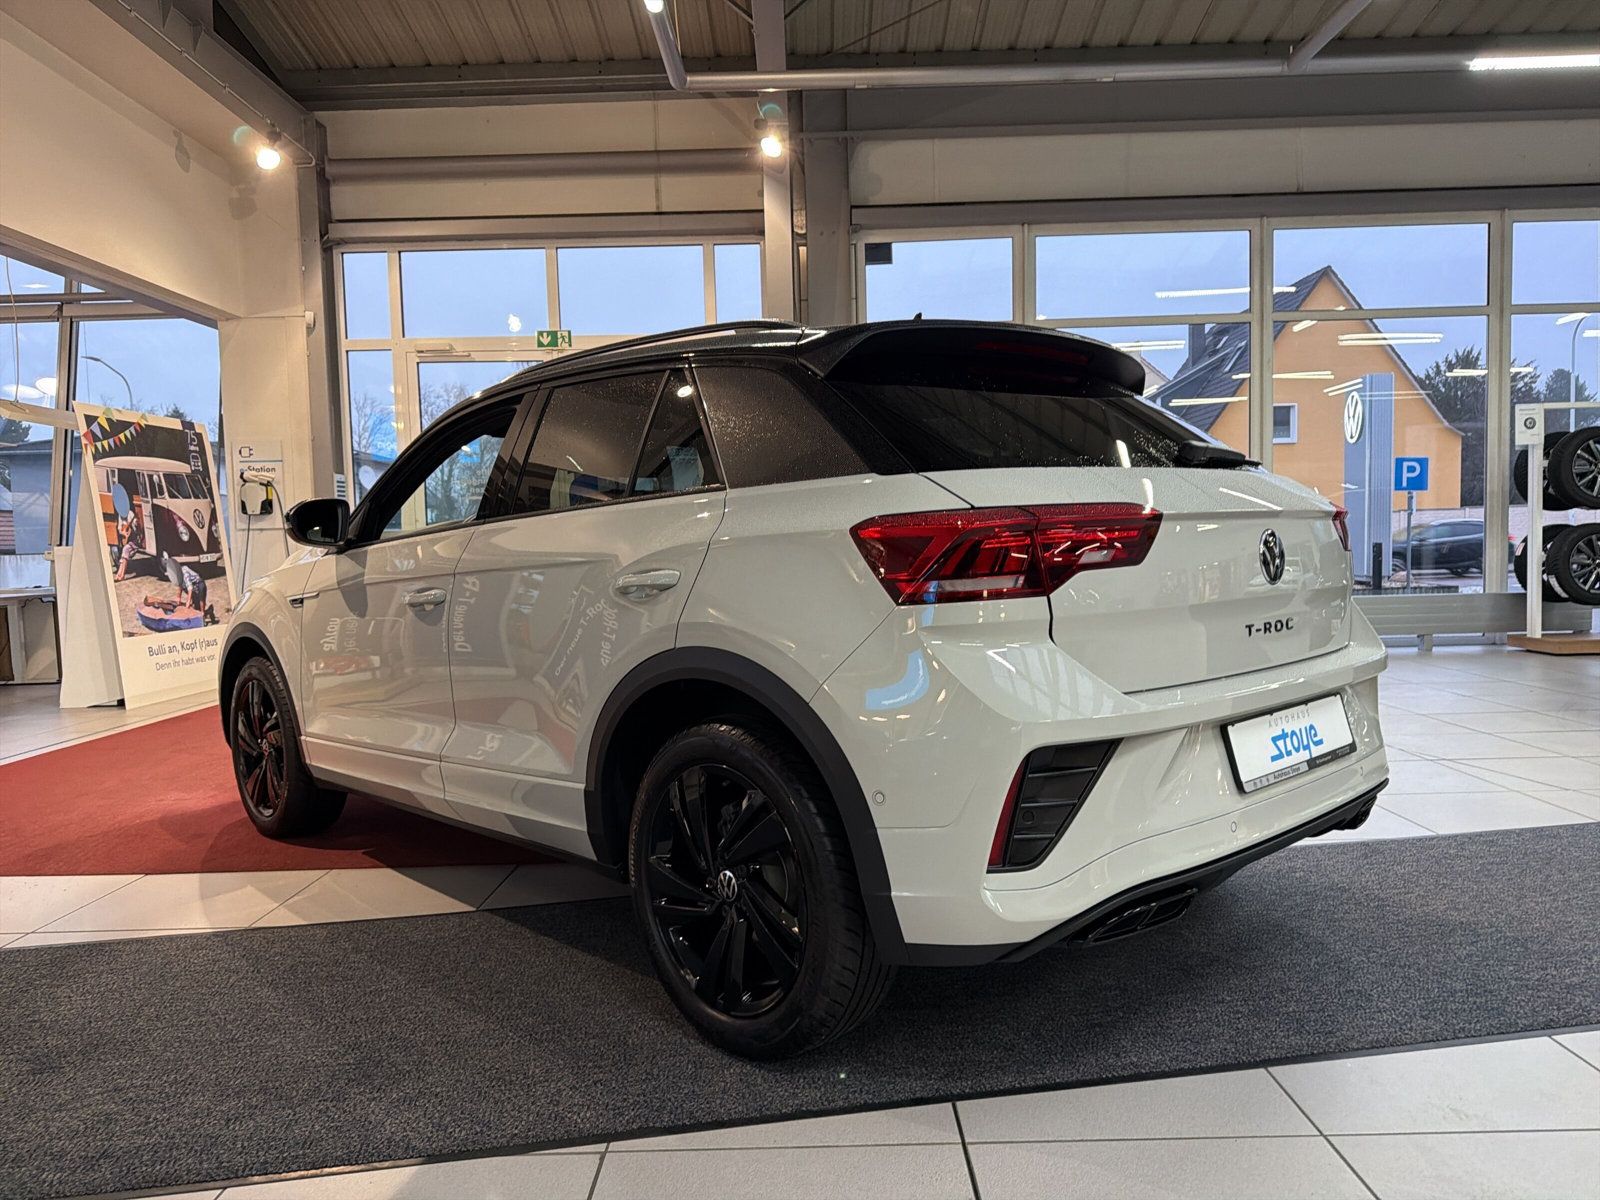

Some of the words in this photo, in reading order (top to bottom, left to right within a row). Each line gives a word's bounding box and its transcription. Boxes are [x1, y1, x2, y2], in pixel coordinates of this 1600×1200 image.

[1402, 460, 1421, 487] P
[1245, 617, 1294, 637] T-ROC
[148, 643, 167, 657] Bulli
[168, 645, 180, 654] an,
[180, 639, 197, 652] Kopf
[155, 661, 172, 671] Denn
[1268, 709, 1310, 728] AUTOHAUS
